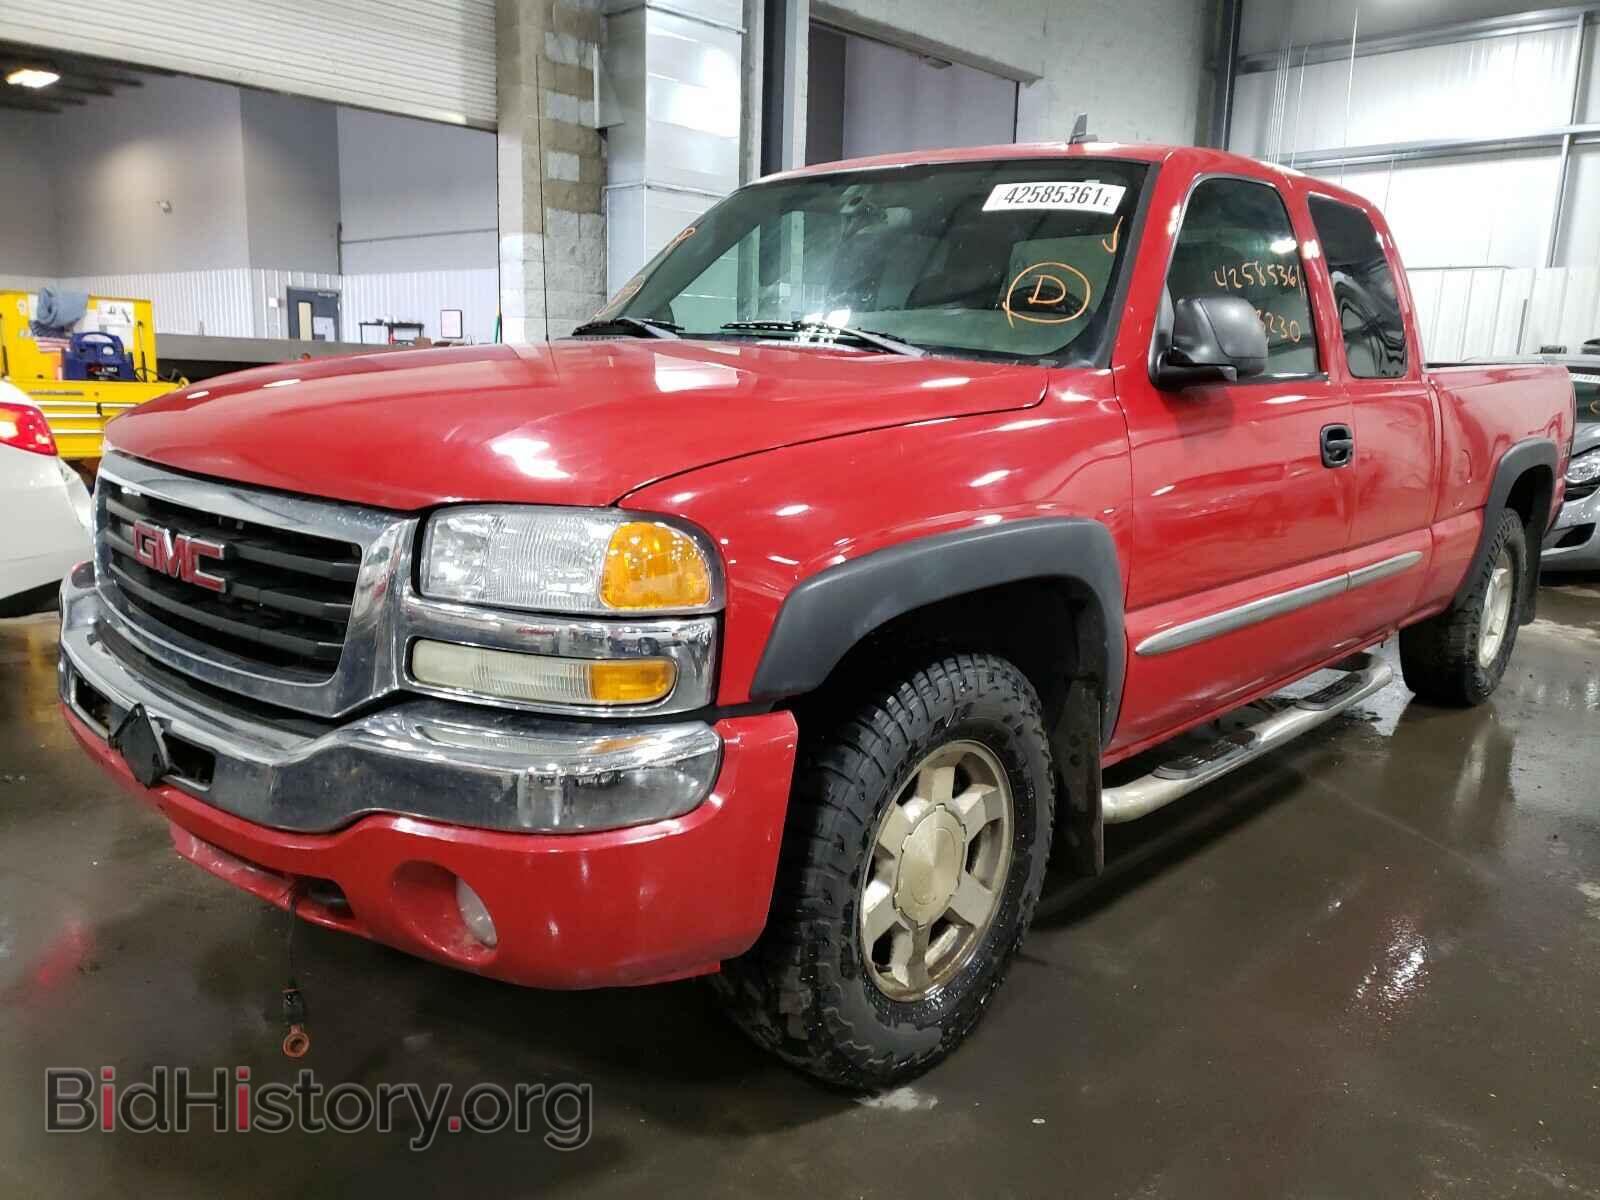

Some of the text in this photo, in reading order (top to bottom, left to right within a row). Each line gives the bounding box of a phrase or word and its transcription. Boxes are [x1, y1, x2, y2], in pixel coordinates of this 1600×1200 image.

[1003, 185, 1103, 205] 42585361
[1027, 274, 1067, 305] D
[1214, 261, 1303, 295] 42585361
[132, 519, 227, 593] GMC
